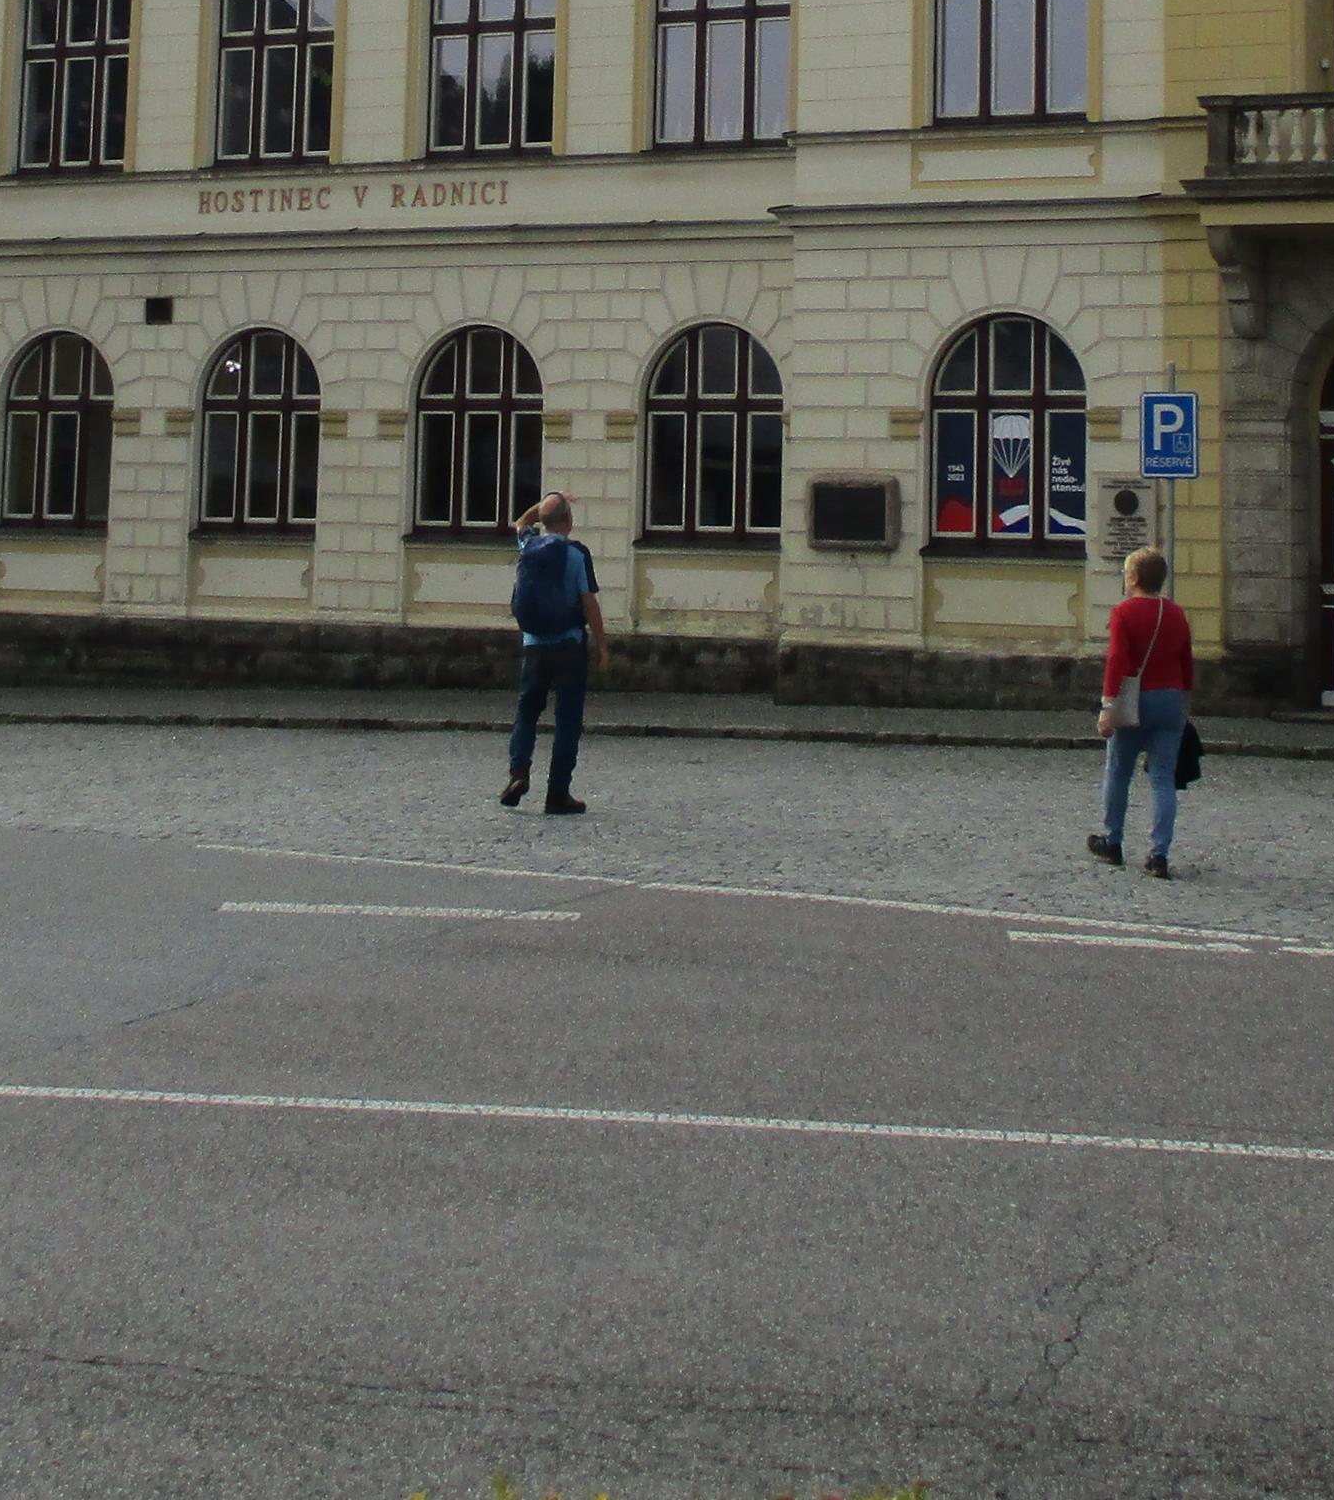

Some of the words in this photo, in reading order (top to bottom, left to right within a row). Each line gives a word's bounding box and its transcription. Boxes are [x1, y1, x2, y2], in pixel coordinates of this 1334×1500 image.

[198, 186, 332, 214] HOSTINEC
[354, 185, 368, 209] V
[391, 181, 510, 208] RADNICI
[1153, 403, 1185, 451] P
[1145, 455, 1193, 468] RÉSERVÉ
